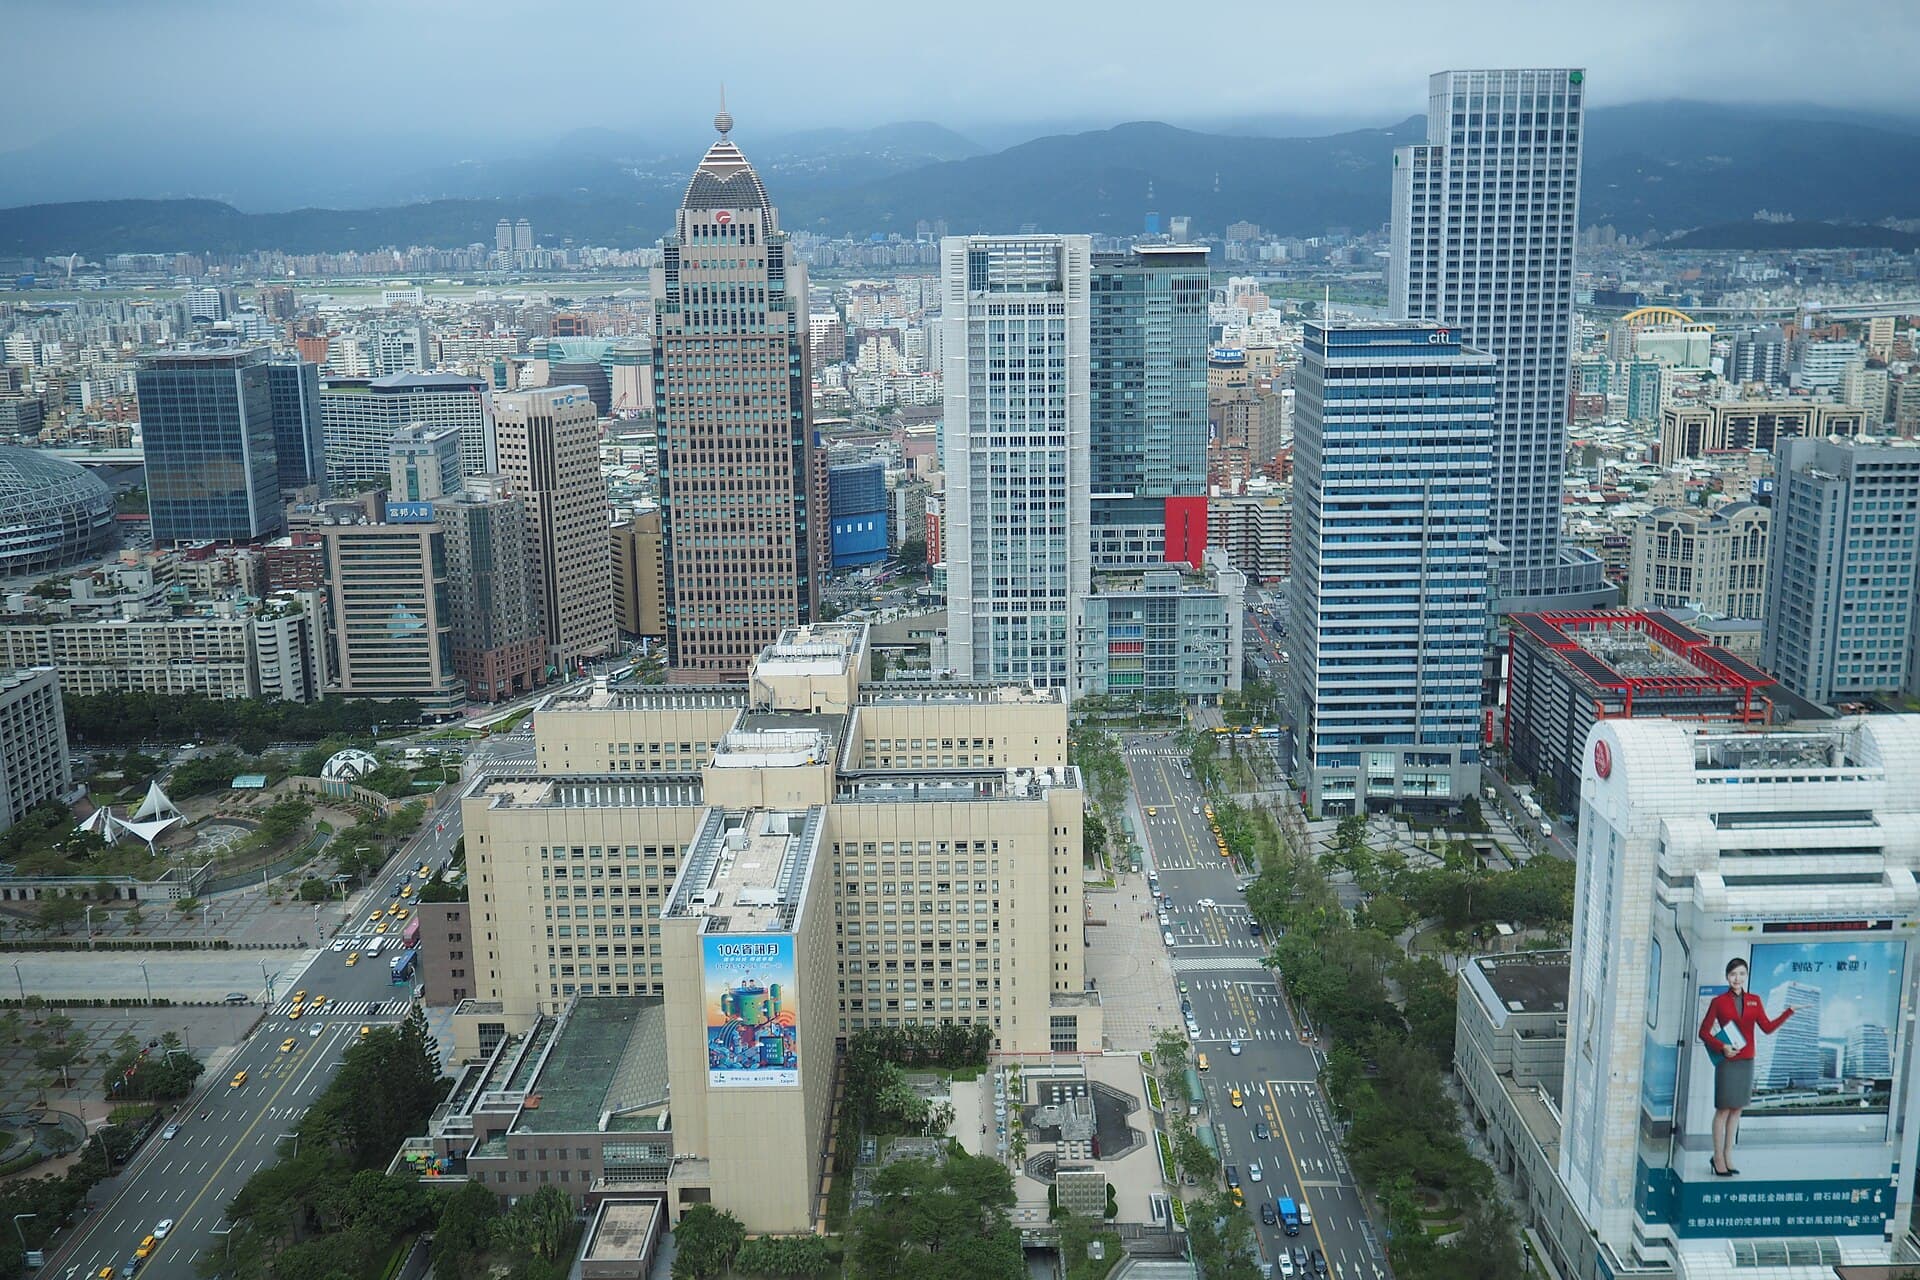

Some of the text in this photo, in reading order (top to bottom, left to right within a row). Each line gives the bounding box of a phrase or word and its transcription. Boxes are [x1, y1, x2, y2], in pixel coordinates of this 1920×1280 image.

[1428, 330, 1450, 344] citi
[389, 507, 428, 517] 富邦人壽
[717, 943, 779, 956] 104資訊月
